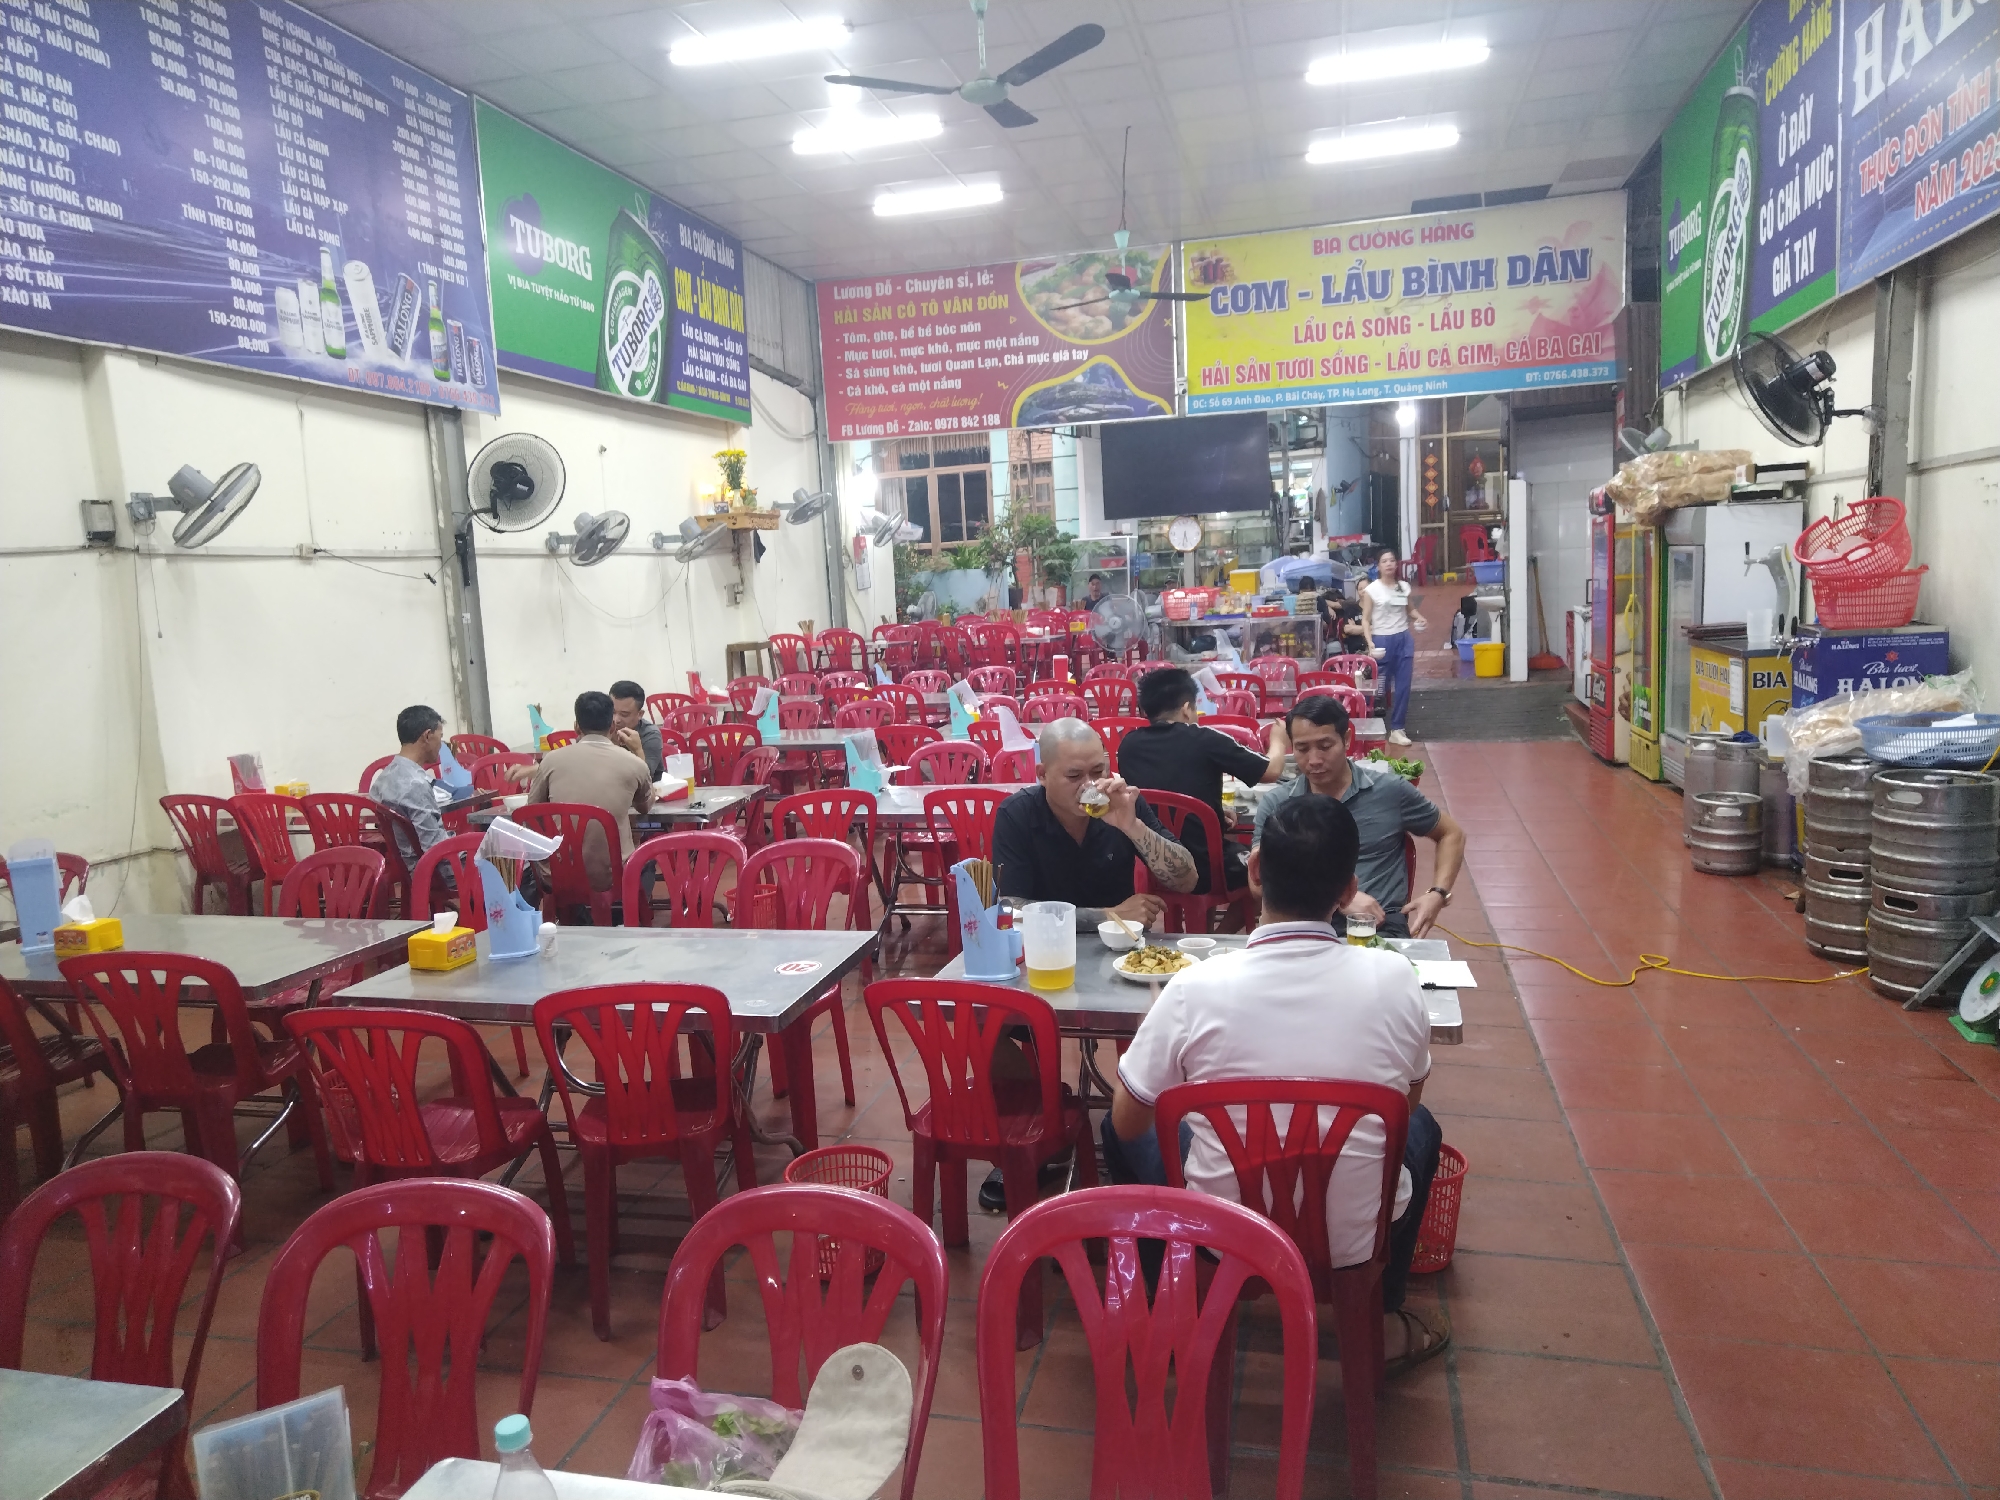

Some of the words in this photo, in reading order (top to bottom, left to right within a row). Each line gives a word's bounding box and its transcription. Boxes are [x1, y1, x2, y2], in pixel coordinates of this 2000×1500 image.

[64, 14, 100, 43] CHUA)
[75, 41, 111, 69] CHUA)
[1787, 93, 1814, 157] ĐÂY
[1860, 136, 1900, 197] THỰC
[1904, 102, 1943, 167] ĐƠN
[1947, 65, 1990, 135] TÍNH
[1759, 189, 1775, 246] CÓ
[1777, 162, 1801, 230] CHẢ
[1804, 144, 1834, 210] MỰC
[1914, 159, 1957, 221] NĂM
[60, 210, 93, 233] CHUA
[87, 195, 123, 220] CHAO)
[208, 212, 234, 231] THEO
[235, 221, 256, 239] CON
[318, 228, 341, 247] SONG
[679, 223, 692, 250] BIA
[1669, 200, 1702, 262] TUBORG
[510, 214, 592, 281] TUBORG
[1313, 237, 1341, 256] BIA
[1298, 290, 1313, 299] -
[1321, 259, 1392, 305] LẨU
[1402, 258, 1497, 297] BÌNH
[1507, 245, 1591, 287] DÂN
[1707, 196, 1743, 345] TUBORG
[1772, 238, 1791, 298] GIÃ
[1793, 228, 1817, 288] TAY
[36, 269, 64, 291] RÁN
[833, 284, 872, 301] Lương
[875, 278, 893, 297] Đỗ
[905, 275, 954, 294] Chuyên
[393, 290, 413, 350] HALONG
[833, 304, 858, 325] HẢI
[862, 302, 892, 323] SẢN
[897, 301, 916, 319] CÔ
[920, 298, 939, 317] TÔ
[943, 296, 973, 315] VÂN
[1294, 316, 1327, 344] LẨU
[1332, 316, 1356, 341] CÁ
[1362, 314, 1411, 339] SONG
[1430, 302, 1465, 332] LẨU
[1471, 302, 1496, 328] BÒ
[612, 295, 657, 383] TUBORG
[843, 332, 871, 345] Tôm,
[900, 345, 925, 359] mực
[928, 342, 953, 355] khô,
[956, 340, 981, 354] mực
[984, 336, 1008, 351] một
[845, 367, 860, 380] Sá
[893, 363, 918, 376] khô,
[945, 359, 975, 372] Quan
[977, 356, 1002, 370] Lạn,
[1004, 352, 1024, 366] Chả
[1026, 351, 1050, 365] mực
[1072, 348, 1089, 361] tay
[1202, 358, 1230, 387] HẢI
[1235, 357, 1271, 384] SẢN
[1276, 358, 1314, 380] TƯƠI
[1320, 348, 1369, 377] SỐNG
[1387, 343, 1421, 372] LẨU
[1427, 343, 1451, 368] CÁ
[1457, 343, 1499, 367] GIM,
[1505, 335, 1531, 363] CÁ
[1537, 336, 1563, 359] BA
[1568, 332, 1602, 357] GAI
[644, 360, 656, 391] GREEN
[846, 384, 861, 397] Cá
[864, 383, 889, 396] khô,
[891, 381, 906, 394] cá
[908, 380, 931, 394] một
[1221, 396, 1233, 407] 69
[1234, 394, 1252, 406] Anh
[1327, 388, 1341, 398] TP.
[1343, 387, 1355, 398] Hạ
[1357, 385, 1382, 397] Long,
[1425, 379, 1448, 390] Ninh
[841, 424, 853, 437] FB
[856, 422, 884, 436] Lương
[886, 419, 899, 434] Đỗ
[908, 419, 932, 432] Zalo:
[934, 417, 959, 430] 0978
[961, 415, 980, 428] 842
[1695, 660, 1705, 676] BIA
[1752, 671, 1788, 690] BIA
[1863, 660, 1891, 675] Bia
[1794, 670, 1818, 695] HALONG
